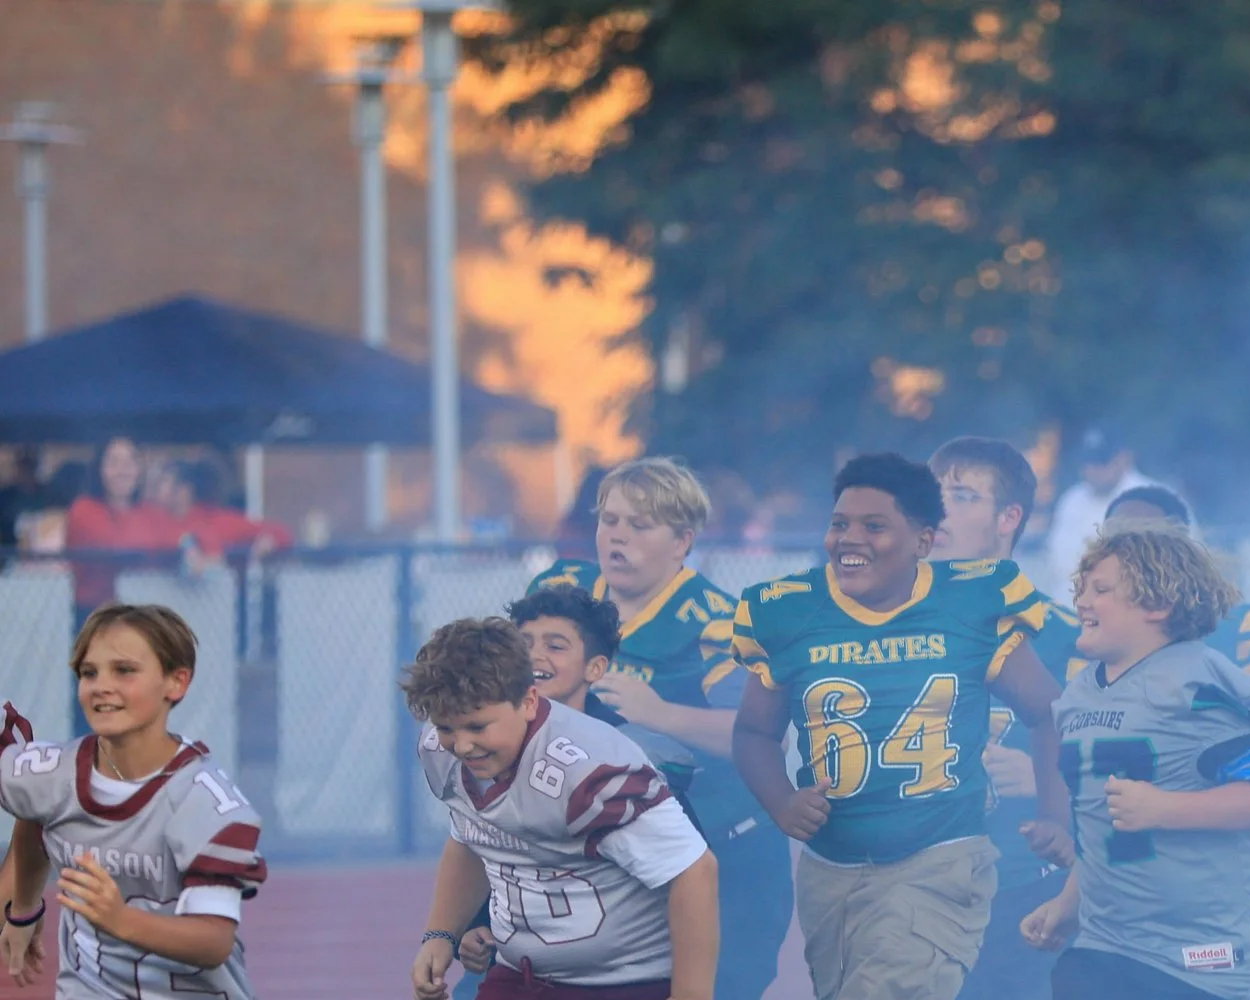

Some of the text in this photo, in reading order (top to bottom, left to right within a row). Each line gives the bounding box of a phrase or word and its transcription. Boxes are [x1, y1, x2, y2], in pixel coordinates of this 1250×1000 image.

[675, 589, 736, 623] 74
[809, 634, 947, 665] PIRATES
[802, 673, 960, 799] 64
[1068, 710, 1125, 734] CORSAIRS
[528, 736, 590, 800] 66
[63, 841, 163, 881] MASON
[1188, 947, 1229, 960] Riddell
